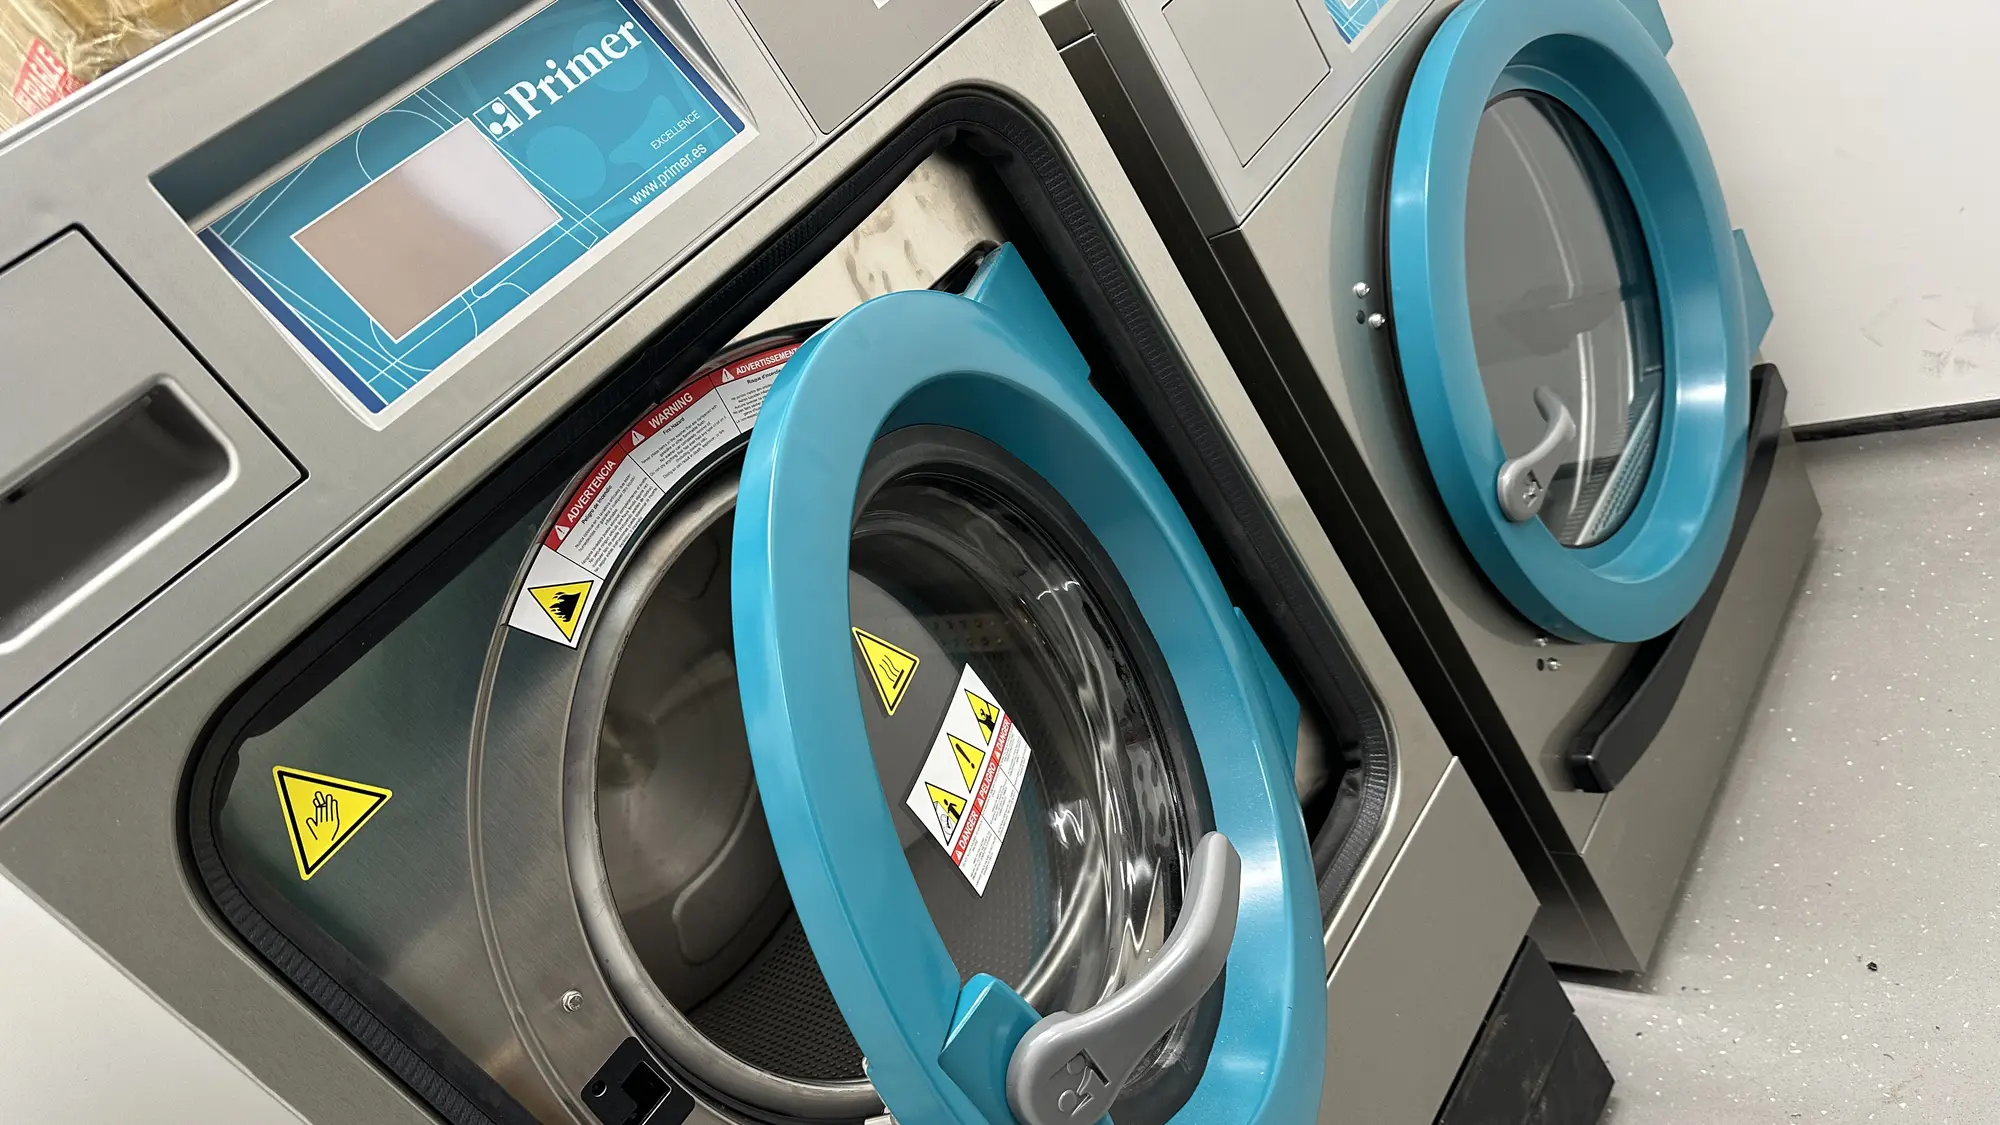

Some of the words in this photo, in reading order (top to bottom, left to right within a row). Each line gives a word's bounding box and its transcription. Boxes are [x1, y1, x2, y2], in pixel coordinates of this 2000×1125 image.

[504, 21, 642, 120] Primer
[650, 110, 700, 150] EXCELLENCE
[628, 142, 707, 205] www.primer.es
[736, 347, 798, 375] ADVERTISSEMENT
[648, 392, 693, 429] WARNING
[567, 460, 616, 522] ADVERTENCIA
[996, 719, 1011, 751] DANGER
[979, 762, 996, 799] PELIGRO
[958, 811, 979, 849] DANGER
